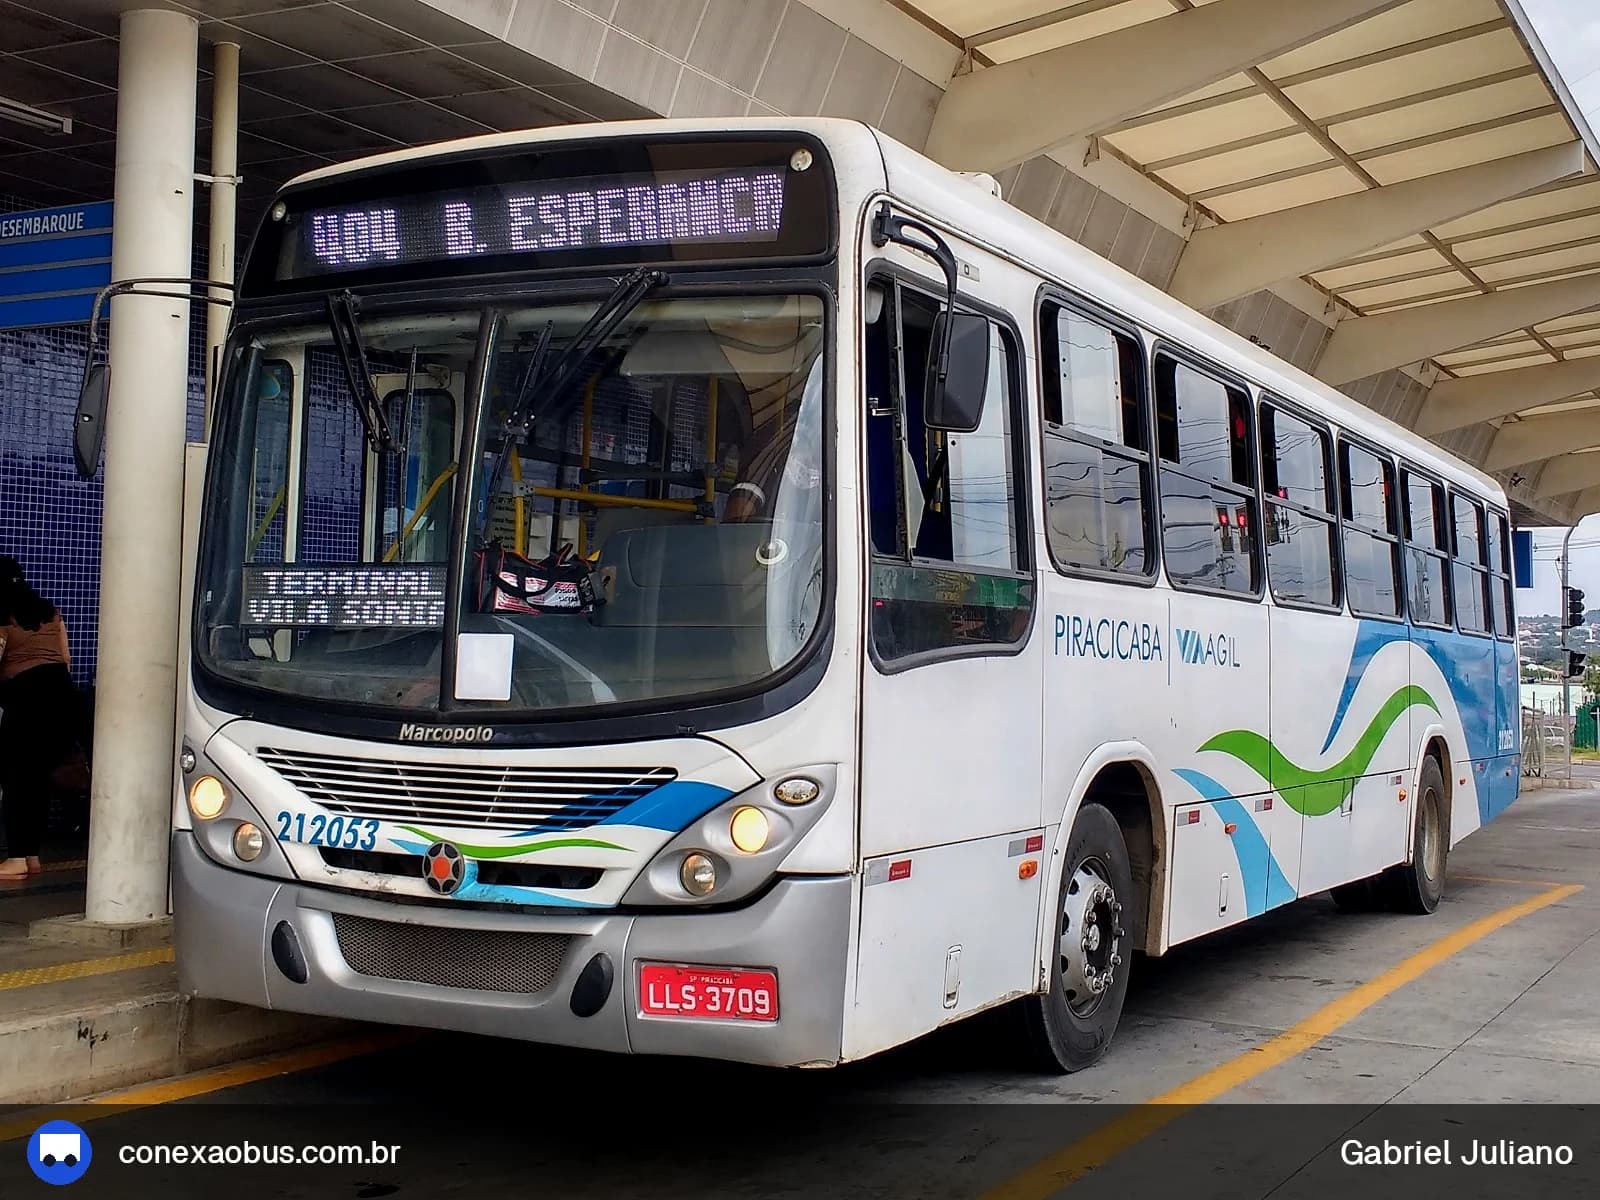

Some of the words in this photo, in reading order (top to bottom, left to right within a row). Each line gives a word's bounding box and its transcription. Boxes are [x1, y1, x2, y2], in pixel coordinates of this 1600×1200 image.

[0, 211, 85, 238] ESEMBARQUE
[313, 209, 400, 264] 404
[445, 202, 488, 255] B.
[263, 571, 442, 595] TERMINAL
[249, 599, 329, 623] VILA
[1055, 614, 1163, 662] PIRACICABA
[399, 723, 494, 745] Marcopolo
[277, 810, 380, 852] 212053
